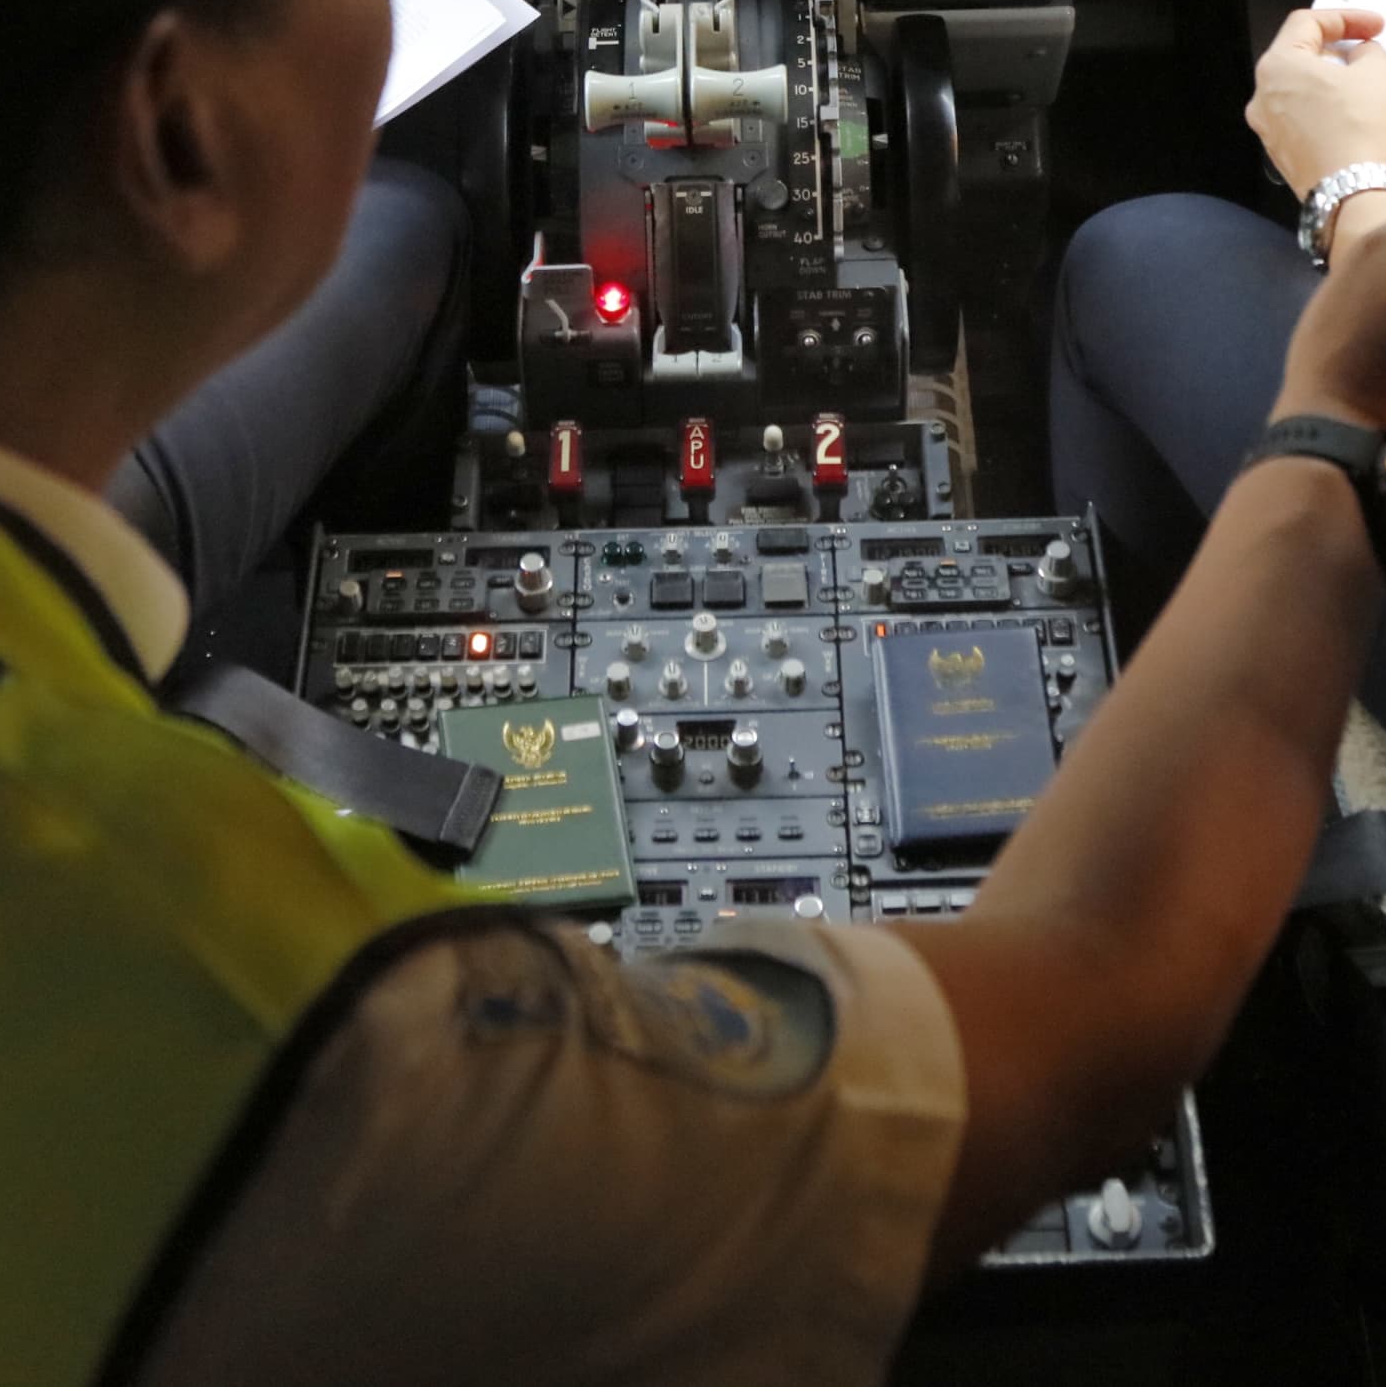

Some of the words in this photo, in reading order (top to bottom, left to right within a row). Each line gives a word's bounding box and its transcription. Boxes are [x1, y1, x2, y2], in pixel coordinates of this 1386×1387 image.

[796, 35, 804, 43] 2
[797, 58, 805, 67] 5
[628, 82, 637, 100] 1
[732, 78, 745, 96] 2
[794, 85, 807, 94] 10
[796, 117, 808, 128] 15
[793, 154, 810, 165] 25
[792, 189, 810, 200] 30
[685, 206, 703, 214] IDLE
[793, 232, 813, 244] 40
[797, 290, 823, 300] STAB
[827, 290, 852, 299] TRIM
[689, 426, 705, 469] APU
[815, 423, 842, 464] 2
[558, 430, 570, 471] 1
